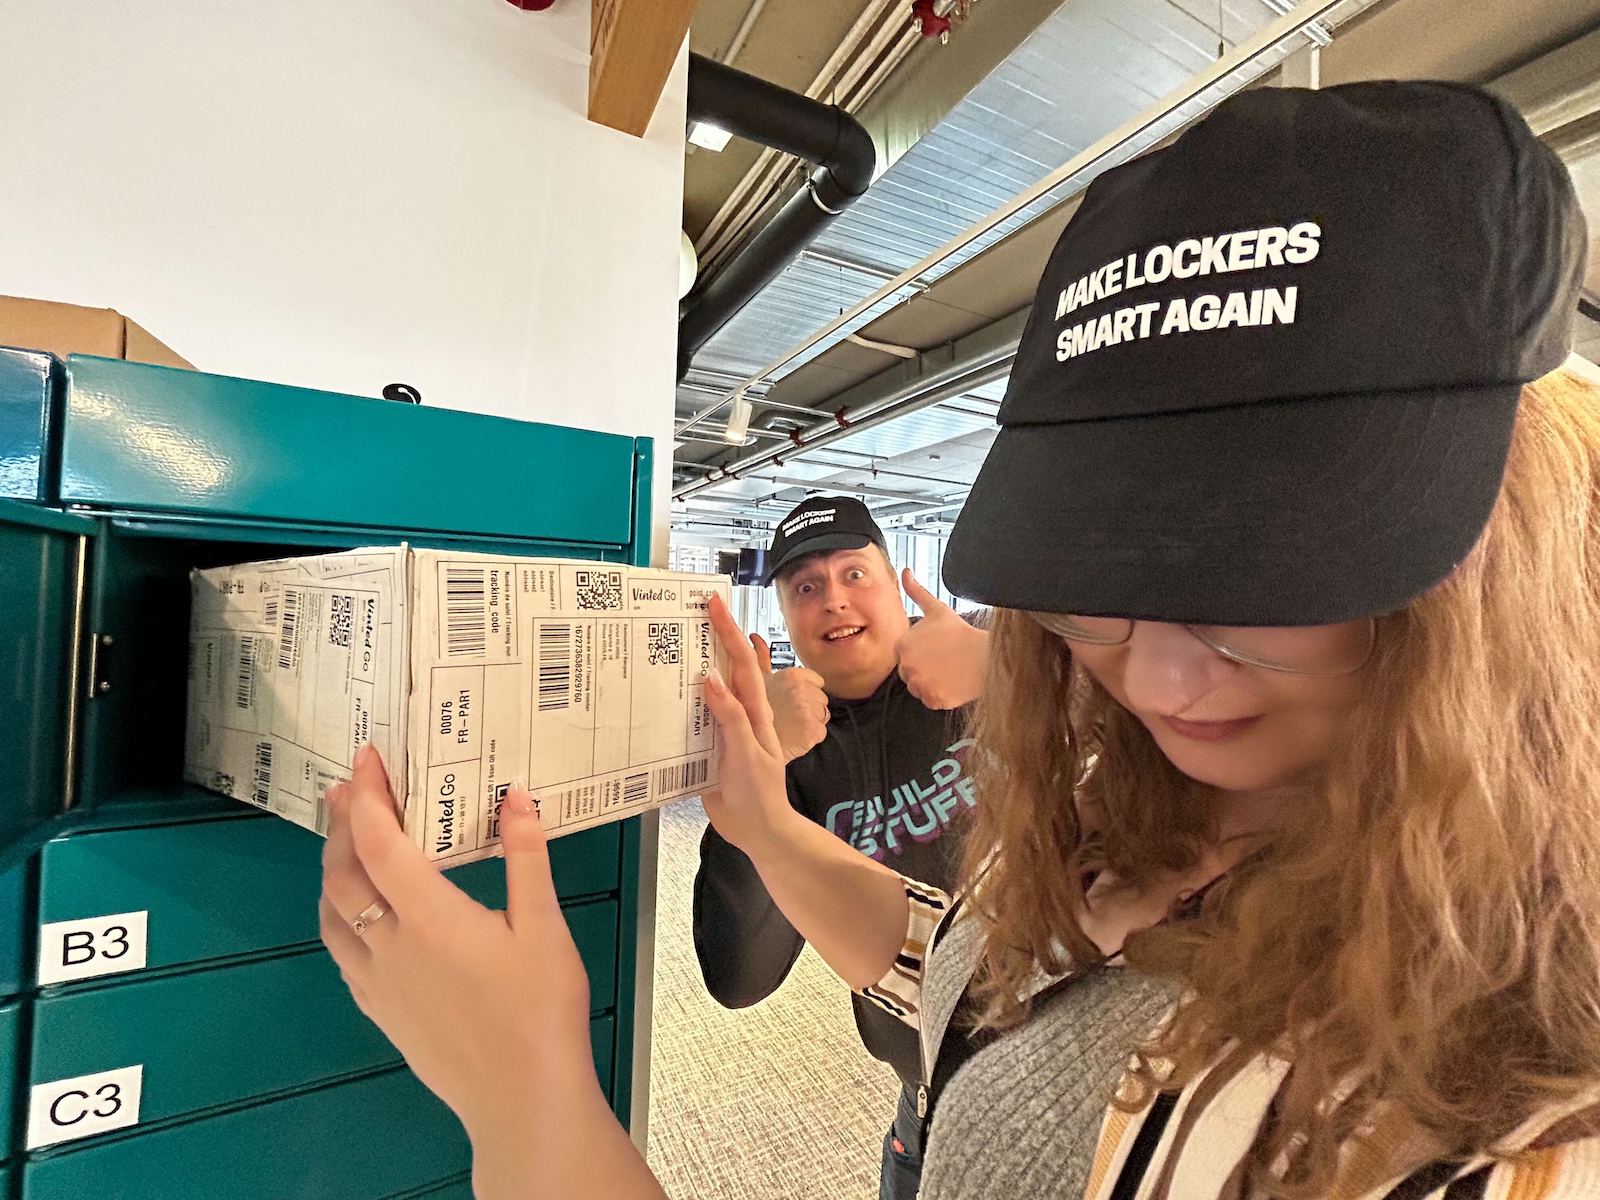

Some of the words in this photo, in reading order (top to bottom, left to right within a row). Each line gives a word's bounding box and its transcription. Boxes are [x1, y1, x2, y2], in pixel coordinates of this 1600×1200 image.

[1055, 258, 1124, 321] MAKE
[1125, 221, 1322, 289] LOCKERS
[1055, 302, 1161, 362] SMART
[1160, 286, 1298, 336] AGAIN
[782, 516, 801, 531] MAKE
[801, 508, 836, 521] LOCKERS
[784, 521, 809, 538] SMART
[808, 515, 834, 526] AGAIN
[489, 569, 500, 634] tracking_code
[632, 587, 663, 602] Vinted
[663, 589, 677, 602] Go
[365, 597, 375, 649] Vinted
[700, 622, 710, 659] Vinted
[362, 651, 371, 672] Go
[700, 660, 710, 677] Go
[440, 701, 453, 735] 00076
[440, 773, 456, 796] Go
[852, 758, 962, 827] BUILD
[436, 799, 455, 853] Vinted
[62, 925, 130, 967] B3
[49, 1083, 122, 1126] C3
